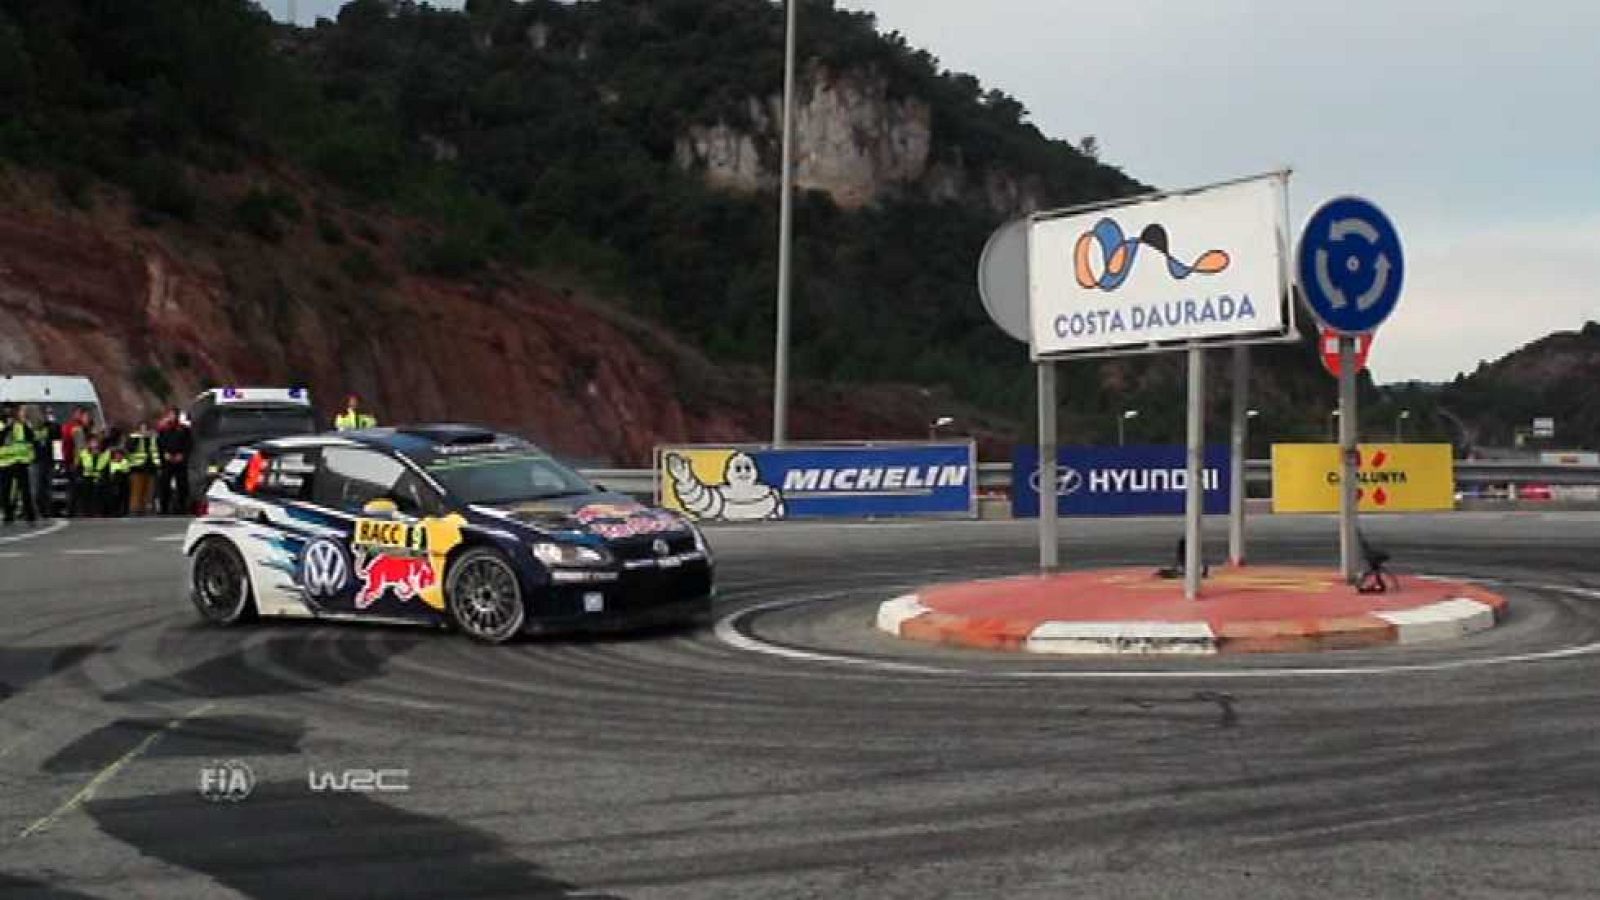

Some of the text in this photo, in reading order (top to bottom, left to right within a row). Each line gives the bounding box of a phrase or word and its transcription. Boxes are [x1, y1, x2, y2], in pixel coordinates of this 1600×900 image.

[1054, 294, 1256, 339] COSTA DAURADA
[782, 465, 968, 491] MICHELIN
[360, 522, 402, 546] RACC
